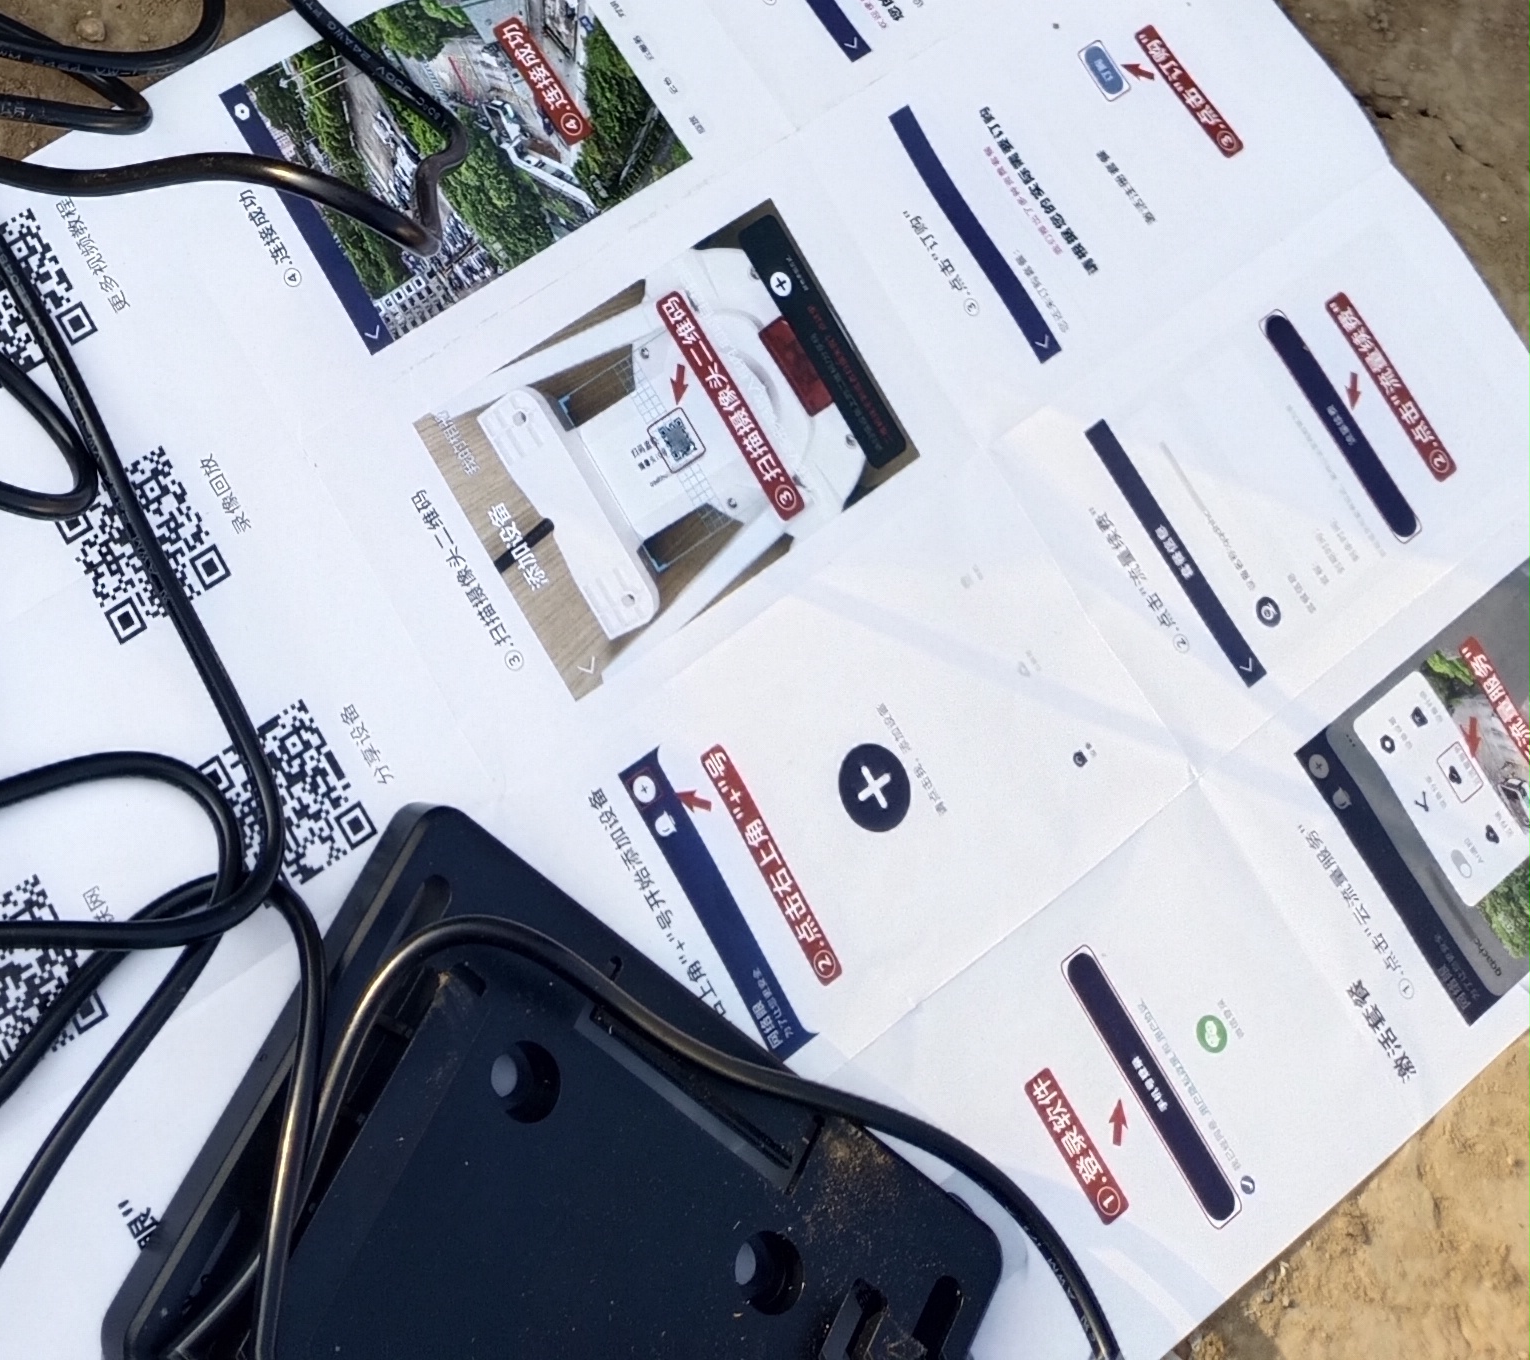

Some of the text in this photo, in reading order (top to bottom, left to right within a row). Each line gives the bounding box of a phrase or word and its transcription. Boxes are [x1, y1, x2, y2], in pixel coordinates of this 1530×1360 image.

[497, 20, 587, 140] ④.连接成功
[1092, 55, 1115, 83] 订购
[976, 103, 1100, 276] 请根据您的实际需要订购
[1094, 146, 1158, 226] 激活注册套餐
[50, 194, 133, 316] 更多视频教程
[234, 186, 305, 290] ④.连接成功
[659, 292, 803, 514] ③.扫描摄像头二维码
[194, 451, 256, 537] 录像回放
[407, 486, 528, 675] ③.扫描摄像头二维码
[483, 498, 551, 593] 添加设备
[1153, 522, 1196, 580] 套餐信息
[336, 700, 396, 787] 分享设备
[748, 998, 785, 1050] 网络眼
[1342, 976, 1420, 1084] 激活套餐
[1130, 1053, 1171, 1113] 手机号登录
[1026, 1071, 1126, 1219] ①.登录软件
